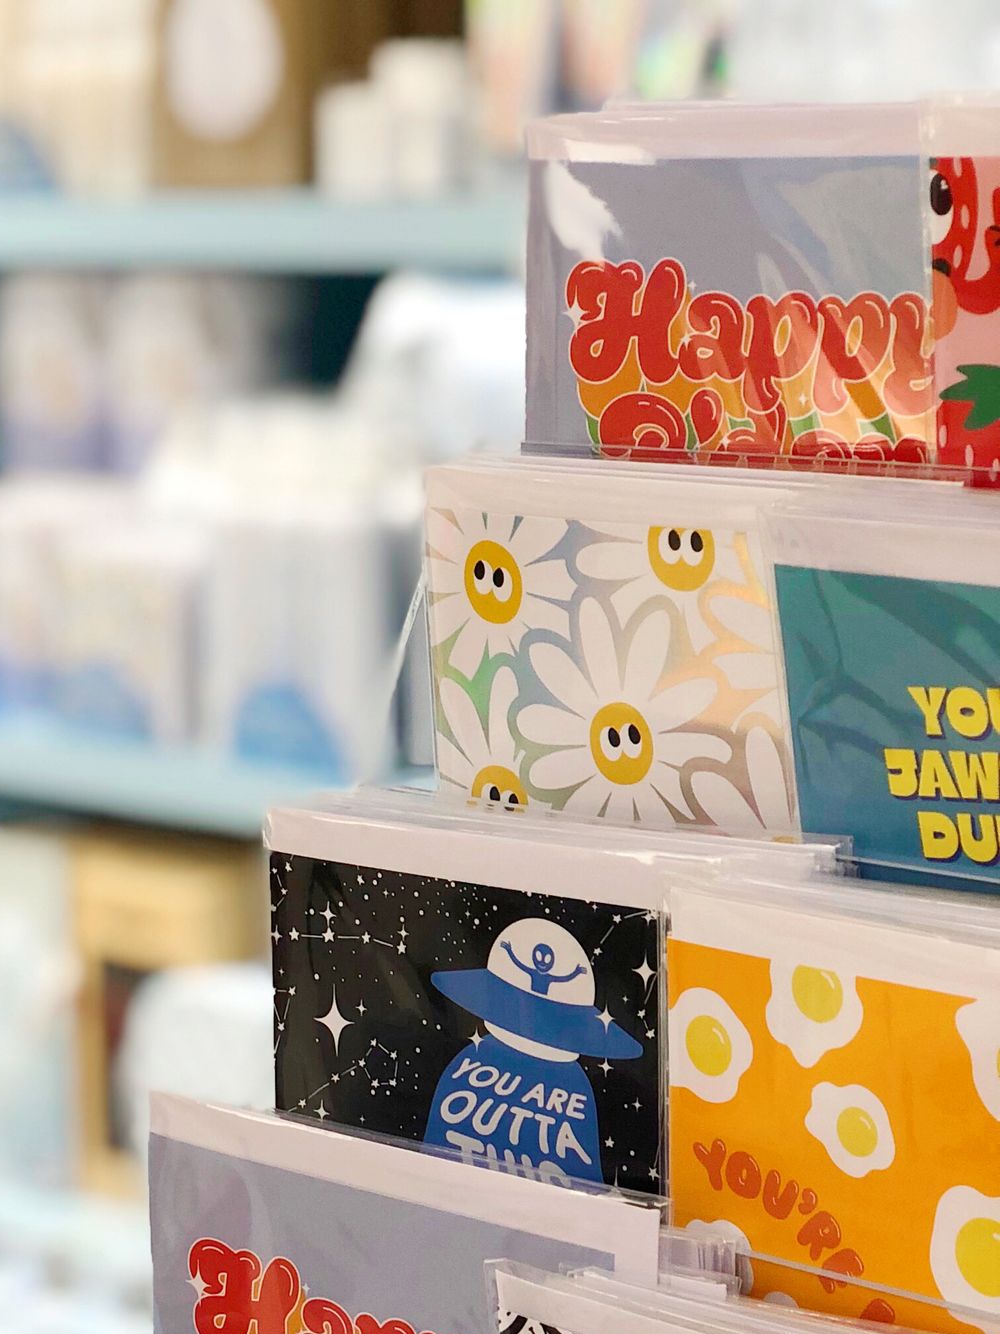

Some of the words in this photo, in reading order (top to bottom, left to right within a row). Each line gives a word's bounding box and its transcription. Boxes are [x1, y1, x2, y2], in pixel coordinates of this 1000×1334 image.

[451, 1057, 523, 1096] YOU
[521, 1082, 588, 1120] ARE
[440, 1090, 593, 1165] OUTTA
